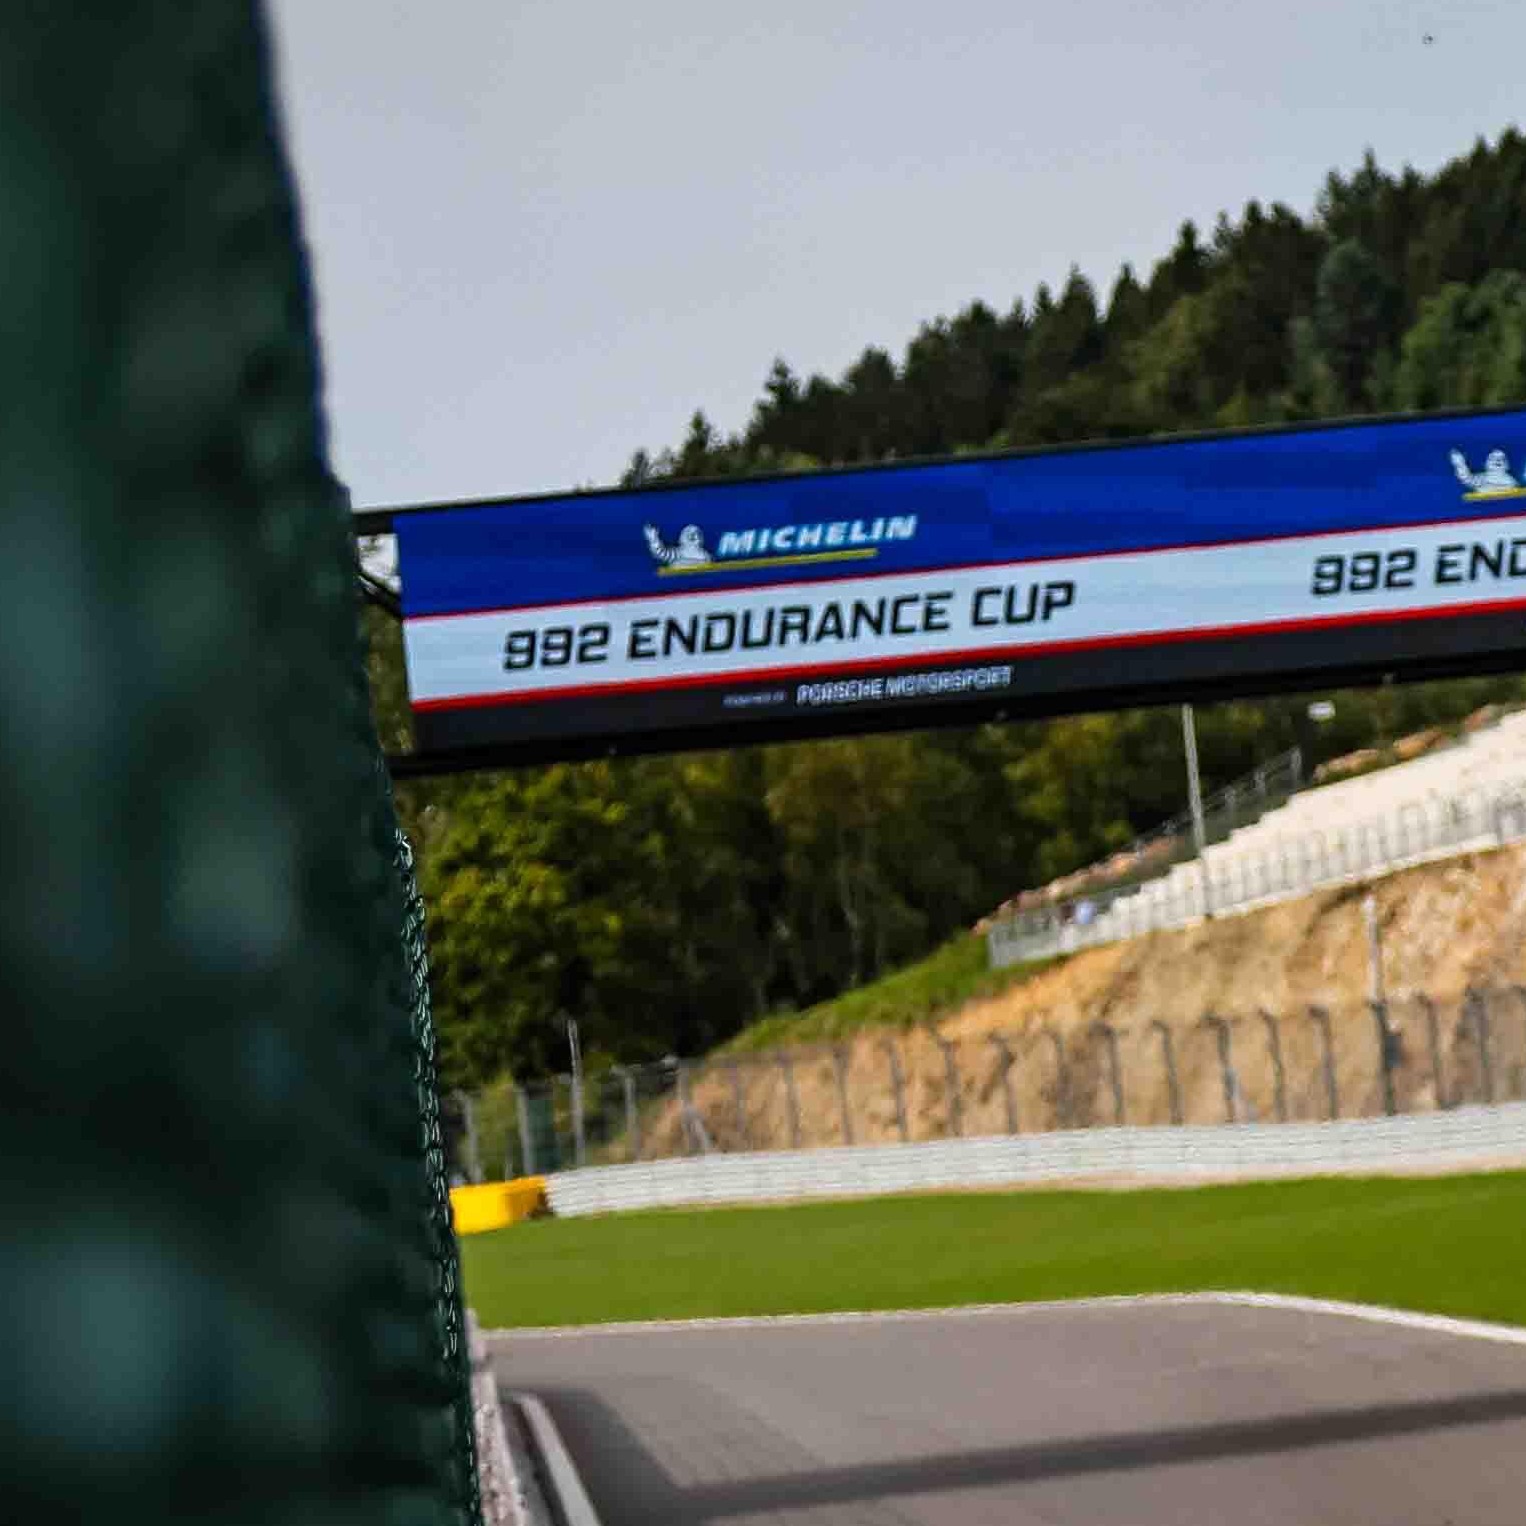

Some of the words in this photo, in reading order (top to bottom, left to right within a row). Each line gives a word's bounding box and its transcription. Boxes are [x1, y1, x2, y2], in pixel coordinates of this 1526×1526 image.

[717, 514, 917, 556] MICHELIN
[1311, 545, 1416, 597] 992
[503, 622, 610, 673] 992
[628, 592, 953, 661] ENDURANCE
[968, 580, 1076, 628] CUP
